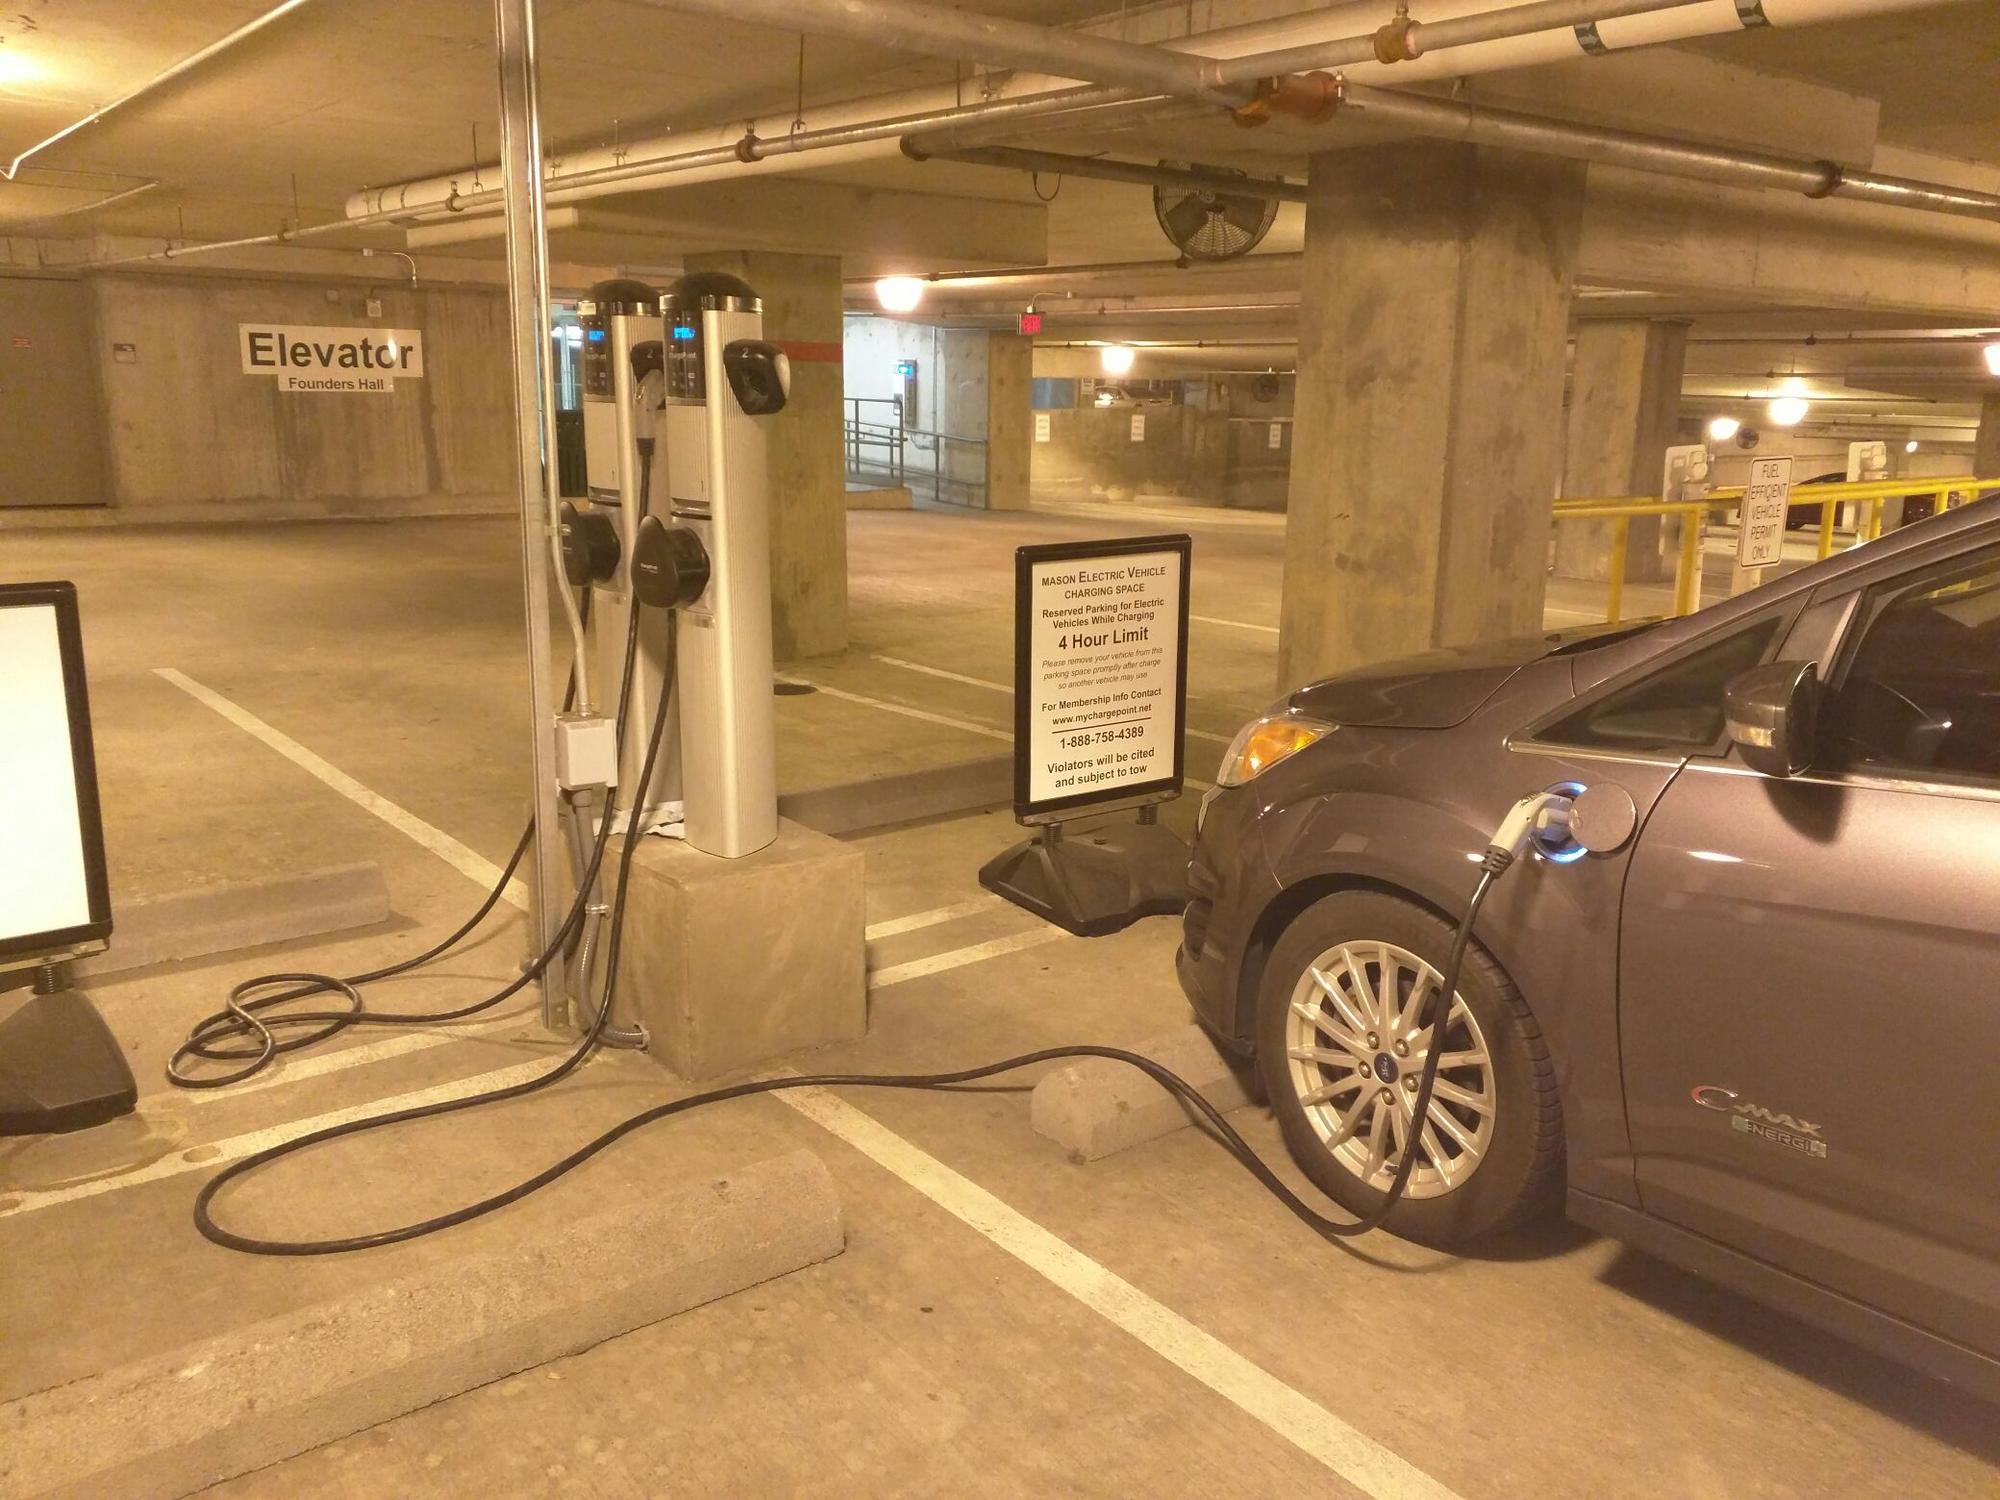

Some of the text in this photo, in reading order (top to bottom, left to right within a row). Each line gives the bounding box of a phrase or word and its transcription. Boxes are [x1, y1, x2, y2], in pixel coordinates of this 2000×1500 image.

[248, 332, 413, 369] Elevator
[647, 349, 653, 358] 2
[742, 347, 749, 358] 2
[288, 378, 384, 390] Founders Hall
[1762, 464, 1779, 478] FUEL
[1751, 483, 1787, 499] EFFICIENT
[1752, 503, 1781, 520] VEHICLE
[1751, 524, 1777, 540] PERMIT
[1752, 544, 1771, 560] ONLY
[1042, 567, 1166, 586] MASON ELECTRIC VEHICLE
[1065, 583, 1145, 599] CHARGING SPACE
[1042, 598, 1164, 618] Reserved Parking for Electric
[1053, 611, 1154, 629] Vehicles While Charging
[1059, 627, 1148, 650] 4 Hour Limit
[1042, 660, 1066, 668] Please
[1068, 656, 1092, 665] remove
[1095, 654, 1110, 664] your
[1111, 651, 1134, 660] vehicle
[1135, 648, 1150, 657] from
[1044, 659, 1161, 680] parking space promptly after charge
[1068, 679, 1094, 688] another
[1096, 676, 1119, 685] vehicle
[1042, 688, 1162, 711] For Membership Info Contact
[1052, 704, 1151, 725] www.mychargepoint.net
[1060, 726, 1144, 749] 1-888-758-4389
[1048, 747, 1154, 774] Violators will be cited
[1055, 765, 1147, 788] and subject to tow
[1745, 1120, 1810, 1151] ENERGI
